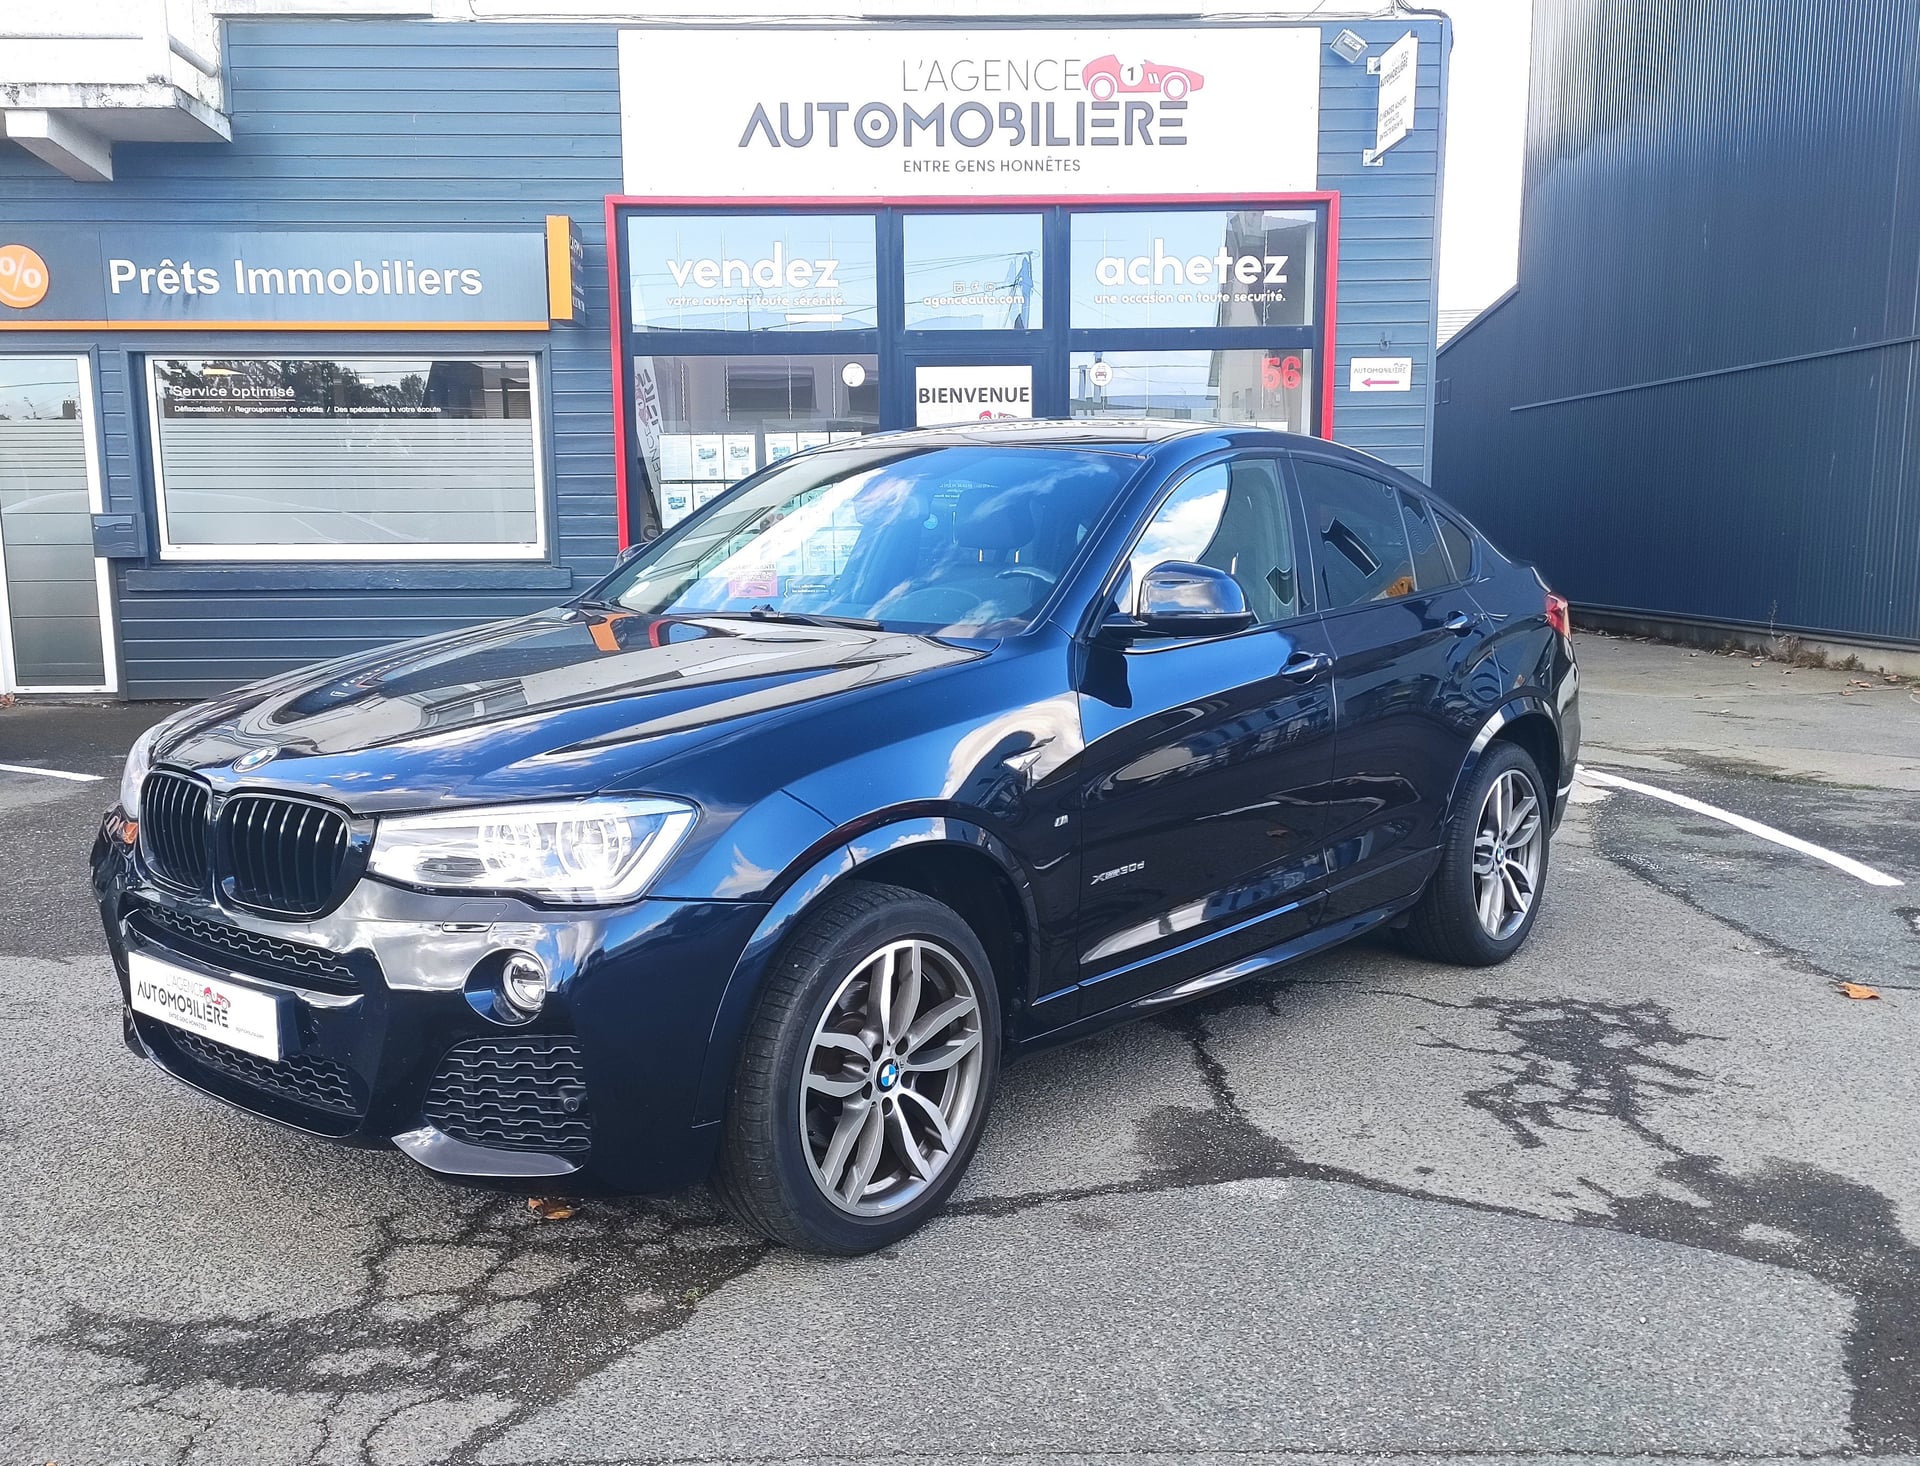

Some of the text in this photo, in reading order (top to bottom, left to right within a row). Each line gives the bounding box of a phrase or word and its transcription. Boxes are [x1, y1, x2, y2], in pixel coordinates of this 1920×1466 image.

[903, 59, 1082, 92] L'AGENCE
[1127, 66, 1135, 81] 1
[903, 155, 1082, 173] ENTRE GENS HONNÊTES
[667, 241, 840, 288] vendez
[1095, 238, 1289, 286] achetez
[108, 259, 483, 296] Prêts Immobiliers
[667, 296, 699, 306] votre
[703, 296, 733, 306] auto
[736, 296, 751, 306] en
[755, 296, 790, 306] toute
[923, 295, 1025, 308] agenceauto.com
[1094, 294, 1118, 304] une
[1121, 291, 1173, 303] occasion
[1177, 293, 1194, 303] en
[1197, 291, 1230, 303] toute
[1262, 356, 1302, 390] 56
[173, 386, 295, 398] Service optimisé
[918, 386, 1030, 404] BIENVENUE
[174, 405, 224, 413] Défiscalisation
[235, 405, 287, 414] Regroupement
[299, 405, 324, 413] crédits
[350, 405, 390, 414] spécialistes
